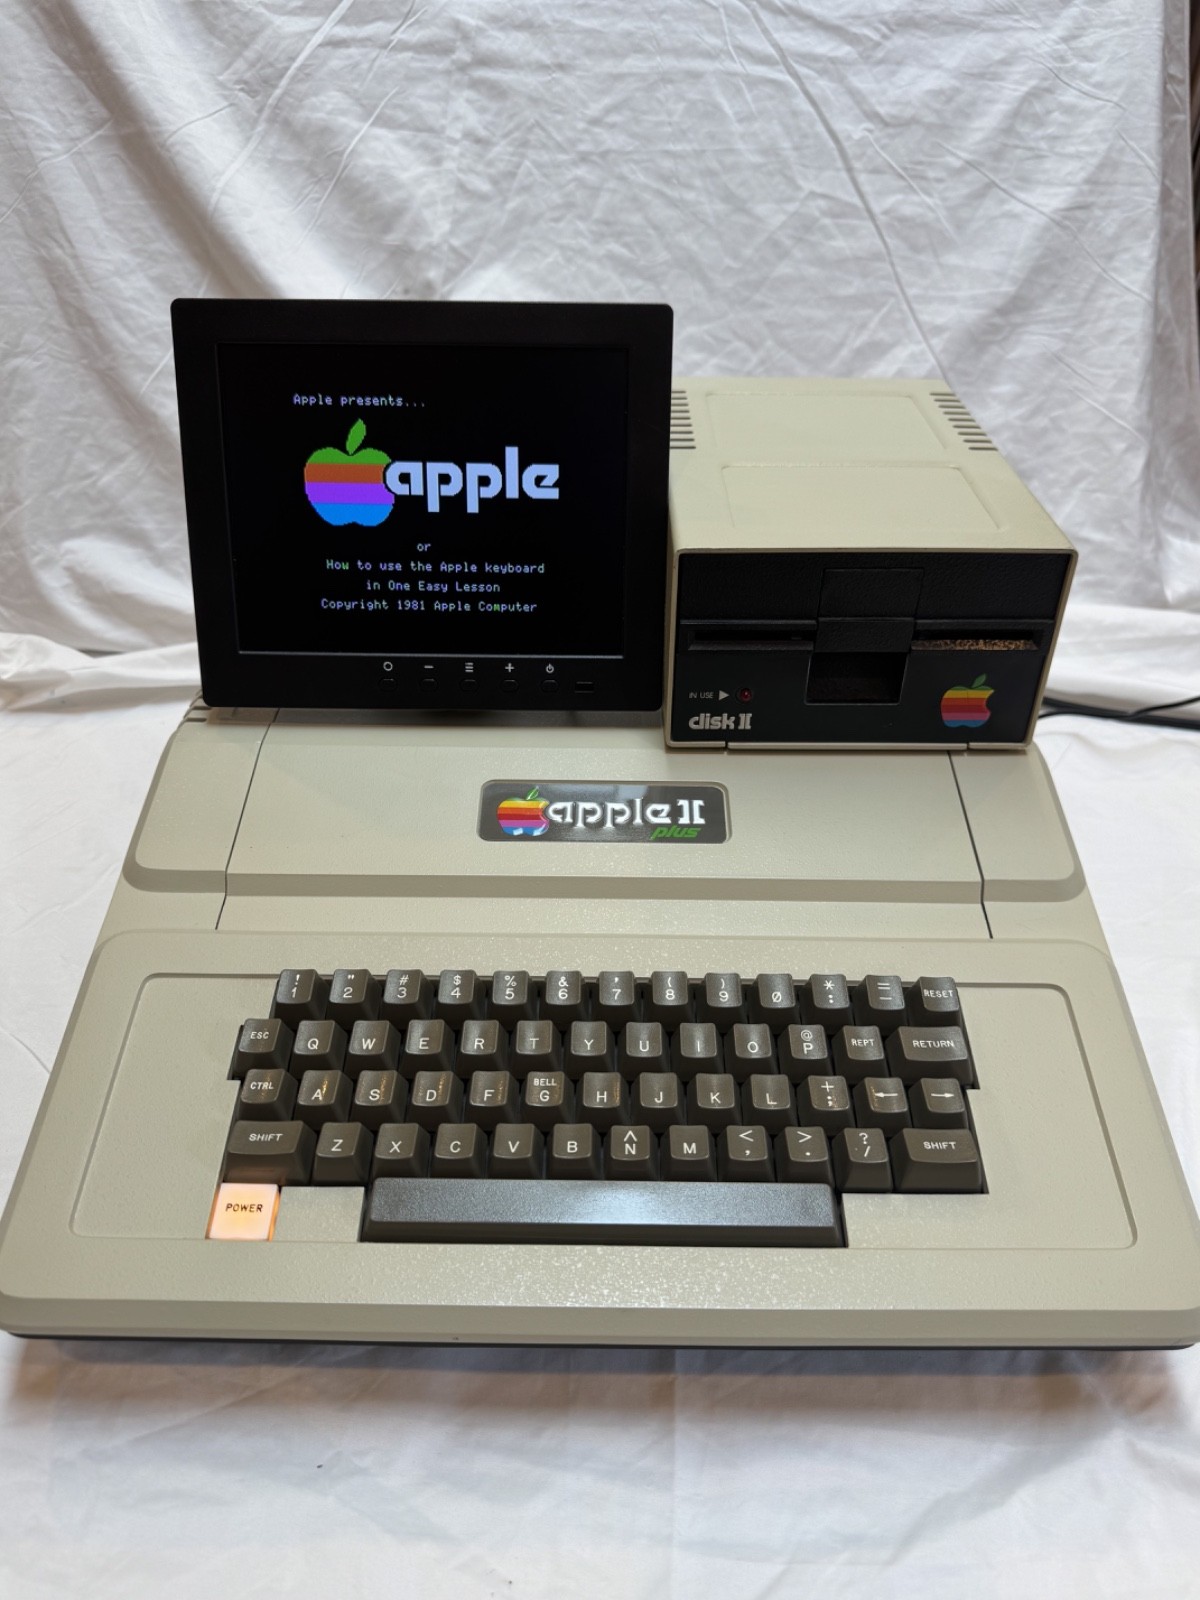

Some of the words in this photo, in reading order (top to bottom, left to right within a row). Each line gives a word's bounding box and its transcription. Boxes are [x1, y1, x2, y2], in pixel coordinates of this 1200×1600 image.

[293, 394, 332, 406] Apple
[386, 446, 560, 513] apple
[417, 543, 430, 552] or
[326, 560, 349, 570] How
[357, 560, 372, 570] to
[380, 562, 402, 571] use
[410, 562, 432, 572] the
[440, 562, 477, 573] Apple
[485, 563, 545, 573] keyboard
[366, 580, 380, 590] in
[388, 581, 410, 590] One
[418, 581, 448, 592] Easy
[456, 582, 500, 592] Lesson
[321, 599, 388, 610] Copyright
[397, 600, 425, 610] 1981
[434, 601, 470, 612] Apple
[478, 602, 537, 612] Computer
[688, 713, 736, 730] disk
[548, 798, 672, 828] apple
[652, 826, 701, 839] plus
[399, 975, 409, 986] #
[453, 975, 461, 986] $
[505, 975, 517, 987] %
[558, 976, 569, 987] &
[291, 987, 298, 998] 1
[343, 987, 353, 998] 2
[397, 988, 407, 998] 3
[450, 988, 461, 999] 4
[504, 989, 515, 999] 5
[558, 989, 568, 999] 6
[612, 989, 621, 999] 7
[665, 990, 675, 1000] 8
[718, 992, 729, 1001] 9
[923, 989, 954, 998] RESET
[250, 1031, 269, 1039] ESC
[801, 1030, 813, 1041] @
[307, 1039, 319, 1050] Q
[362, 1038, 376, 1049] W
[419, 1038, 429, 1049] E
[474, 1039, 484, 1049] R
[529, 1038, 539, 1049] T
[584, 1039, 594, 1050] Y
[639, 1041, 649, 1052] U
[697, 1042, 700, 1052] I
[747, 1042, 759, 1053] O
[851, 1038, 875, 1047] REPT
[913, 1039, 955, 1048] RETURN
[803, 1043, 813, 1054] P
[250, 1082, 274, 1090] CTRL
[534, 1078, 557, 1086] BELL
[821, 1081, 834, 1092] +
[312, 1089, 322, 1100] A
[369, 1089, 380, 1100] S
[426, 1090, 436, 1100] D
[484, 1090, 494, 1100] F
[539, 1091, 550, 1101] G
[596, 1092, 607, 1102] H
[655, 1092, 663, 1103] J
[711, 1092, 720, 1103] K
[766, 1093, 777, 1104] L
[249, 1133, 283, 1142] SHIFT
[739, 1130, 754, 1142] <
[797, 1131, 812, 1143] >
[859, 1133, 869, 1144] ?
[331, 1139, 343, 1152] Z
[390, 1141, 401, 1152] X
[450, 1141, 461, 1152] C
[508, 1141, 520, 1152] V
[567, 1142, 577, 1152] B
[625, 1144, 636, 1155] N
[683, 1143, 696, 1154] M
[923, 1141, 956, 1150] SHIFT
[864, 1146, 871, 1157] /
[225, 1203, 263, 1212] POWER
